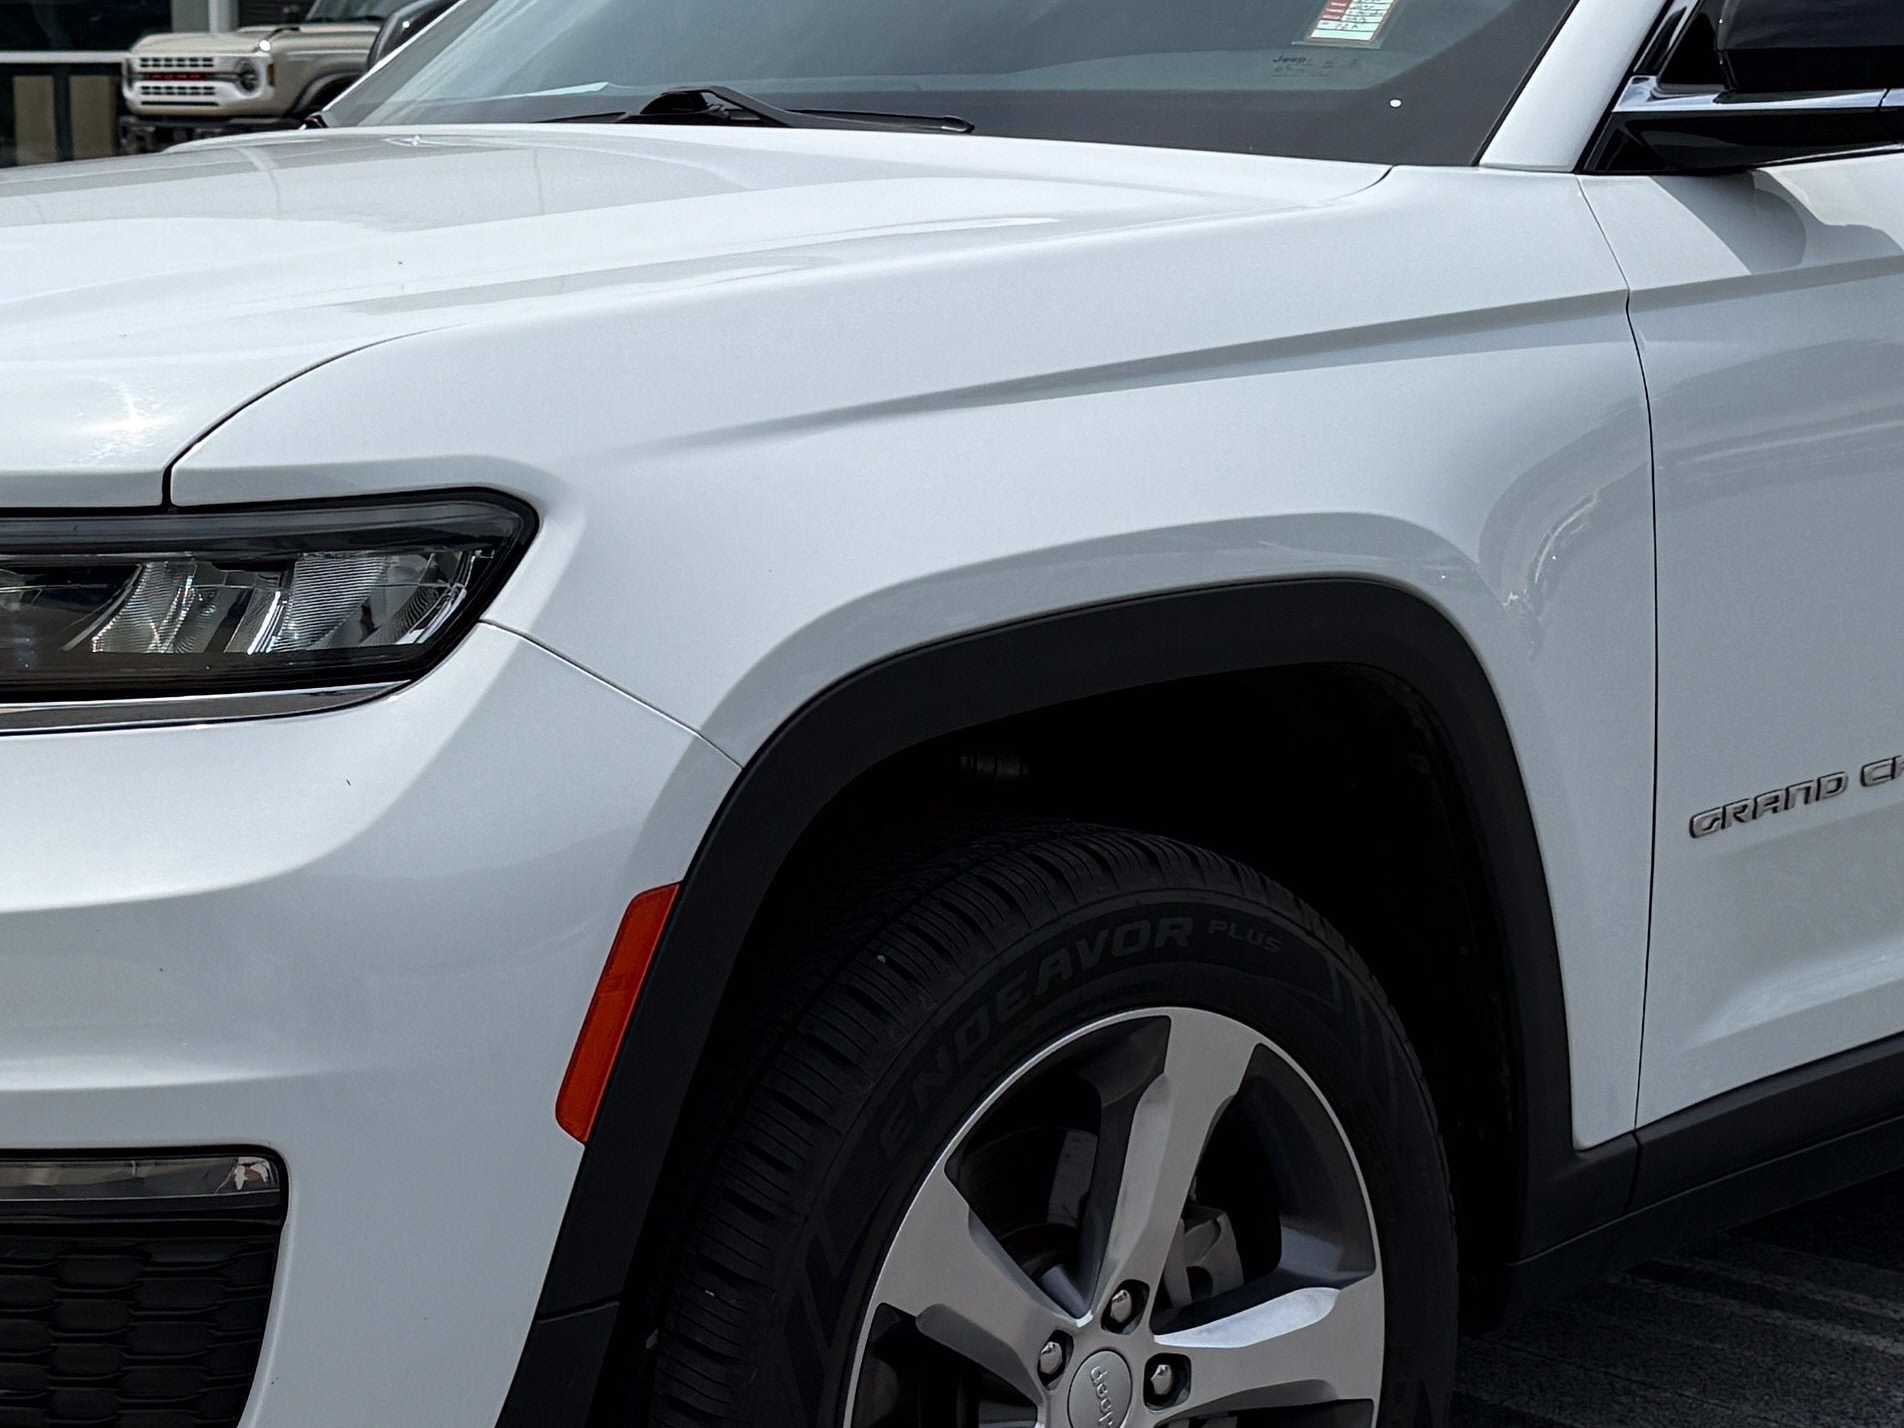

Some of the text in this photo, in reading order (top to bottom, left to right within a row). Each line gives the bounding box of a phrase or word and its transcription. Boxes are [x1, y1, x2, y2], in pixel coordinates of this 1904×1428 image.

[1688, 771, 1850, 839] GRAND
[880, 915, 1283, 1158] ENDEAVOR PLUS
[1089, 1364, 1114, 1428] Jeep
